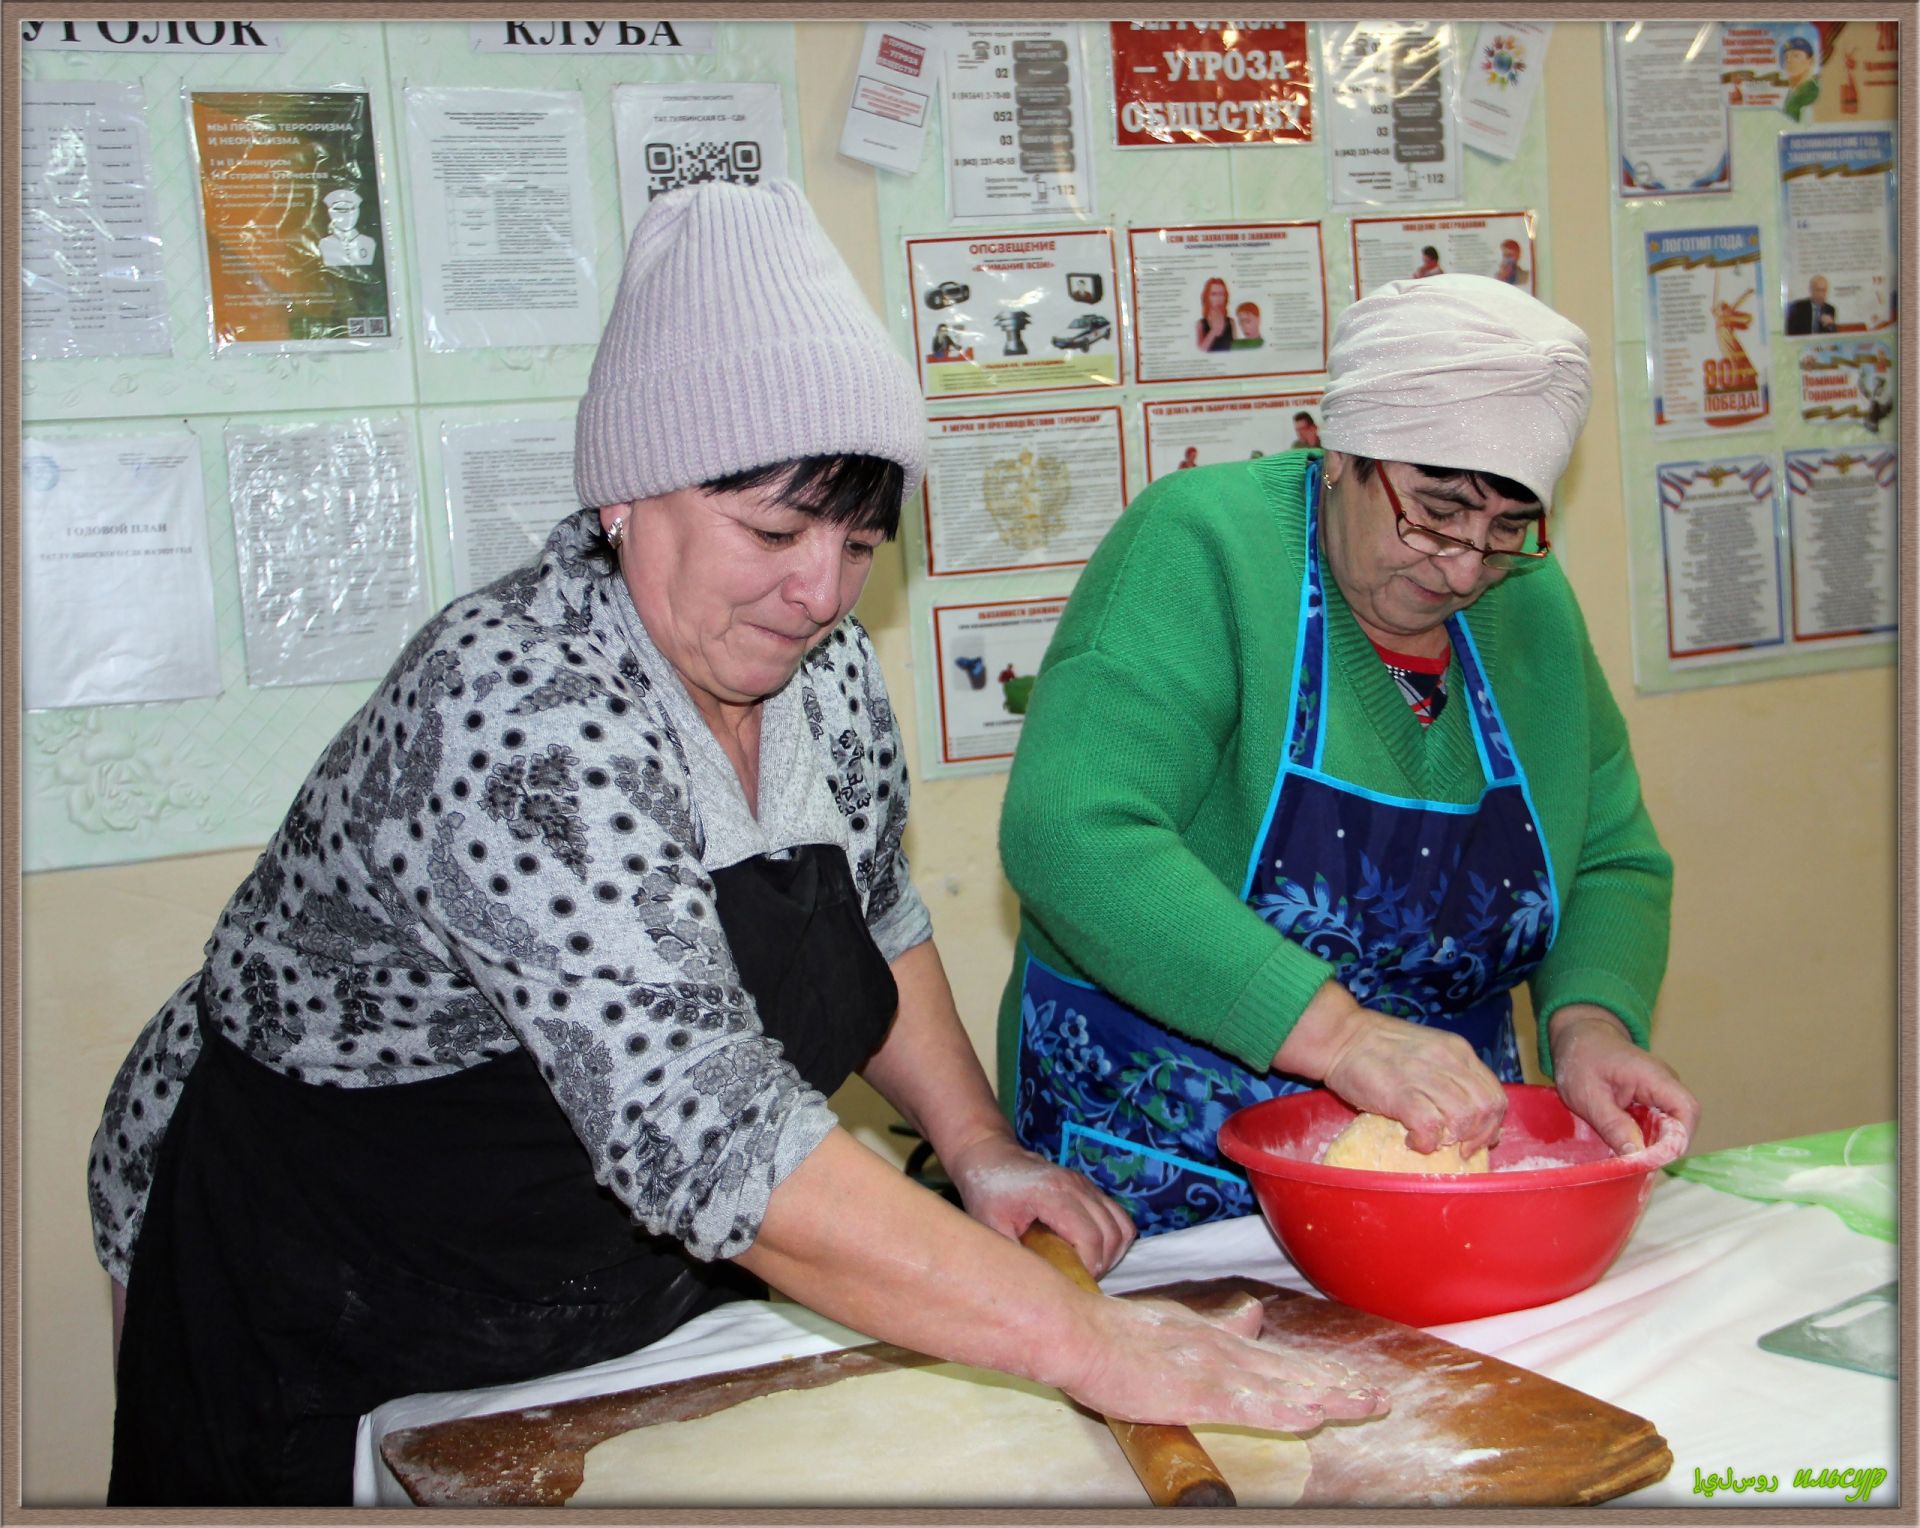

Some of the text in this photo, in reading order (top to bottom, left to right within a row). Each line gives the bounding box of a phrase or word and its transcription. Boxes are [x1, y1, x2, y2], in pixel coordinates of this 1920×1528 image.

[1163, 50, 1291, 82] УГРОЗА
[995, 67, 1009, 78] 02
[993, 111, 1013, 122] 052
[1122, 101, 1301, 133] ОБЩЕСТВУ
[207, 123, 228, 132] МЫ
[279, 123, 354, 132] ТЕРРОРИЗМА
[208, 137, 217, 146] И
[1000, 135, 1013, 146] 03
[1426, 174, 1444, 184] 112
[969, 241, 1056, 255] ОПОВЕЩЕНИЕ
[1662, 233, 1744, 252] ЛОГОТИП ГОДА
[1703, 358, 1733, 389] 80
[67, 523, 167, 537] ГОДОВОЙ ПЛАН
